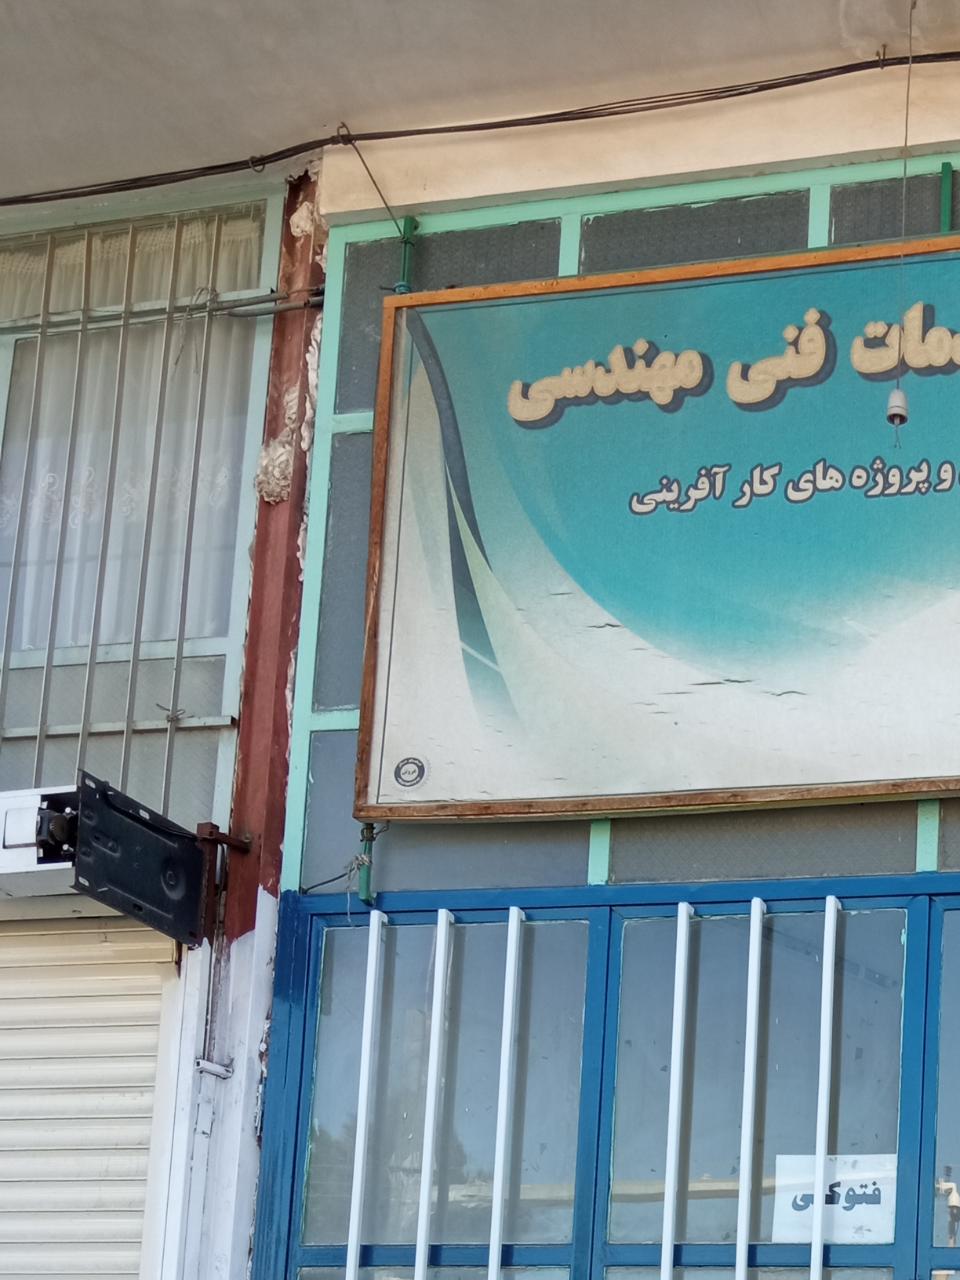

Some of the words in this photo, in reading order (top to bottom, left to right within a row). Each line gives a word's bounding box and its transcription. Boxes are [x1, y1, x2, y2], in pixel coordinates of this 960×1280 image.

[507, 338, 703, 421] مهندسی
[727, 308, 826, 404] فنی
[630, 463, 731, 515] آفرینی
[733, 461, 782, 508] کار
[785, 457, 845, 504] های
[850, 455, 931, 498] پروژه
[934, 460, 957, 492] و
[792, 1181, 881, 1211] فتوکی
